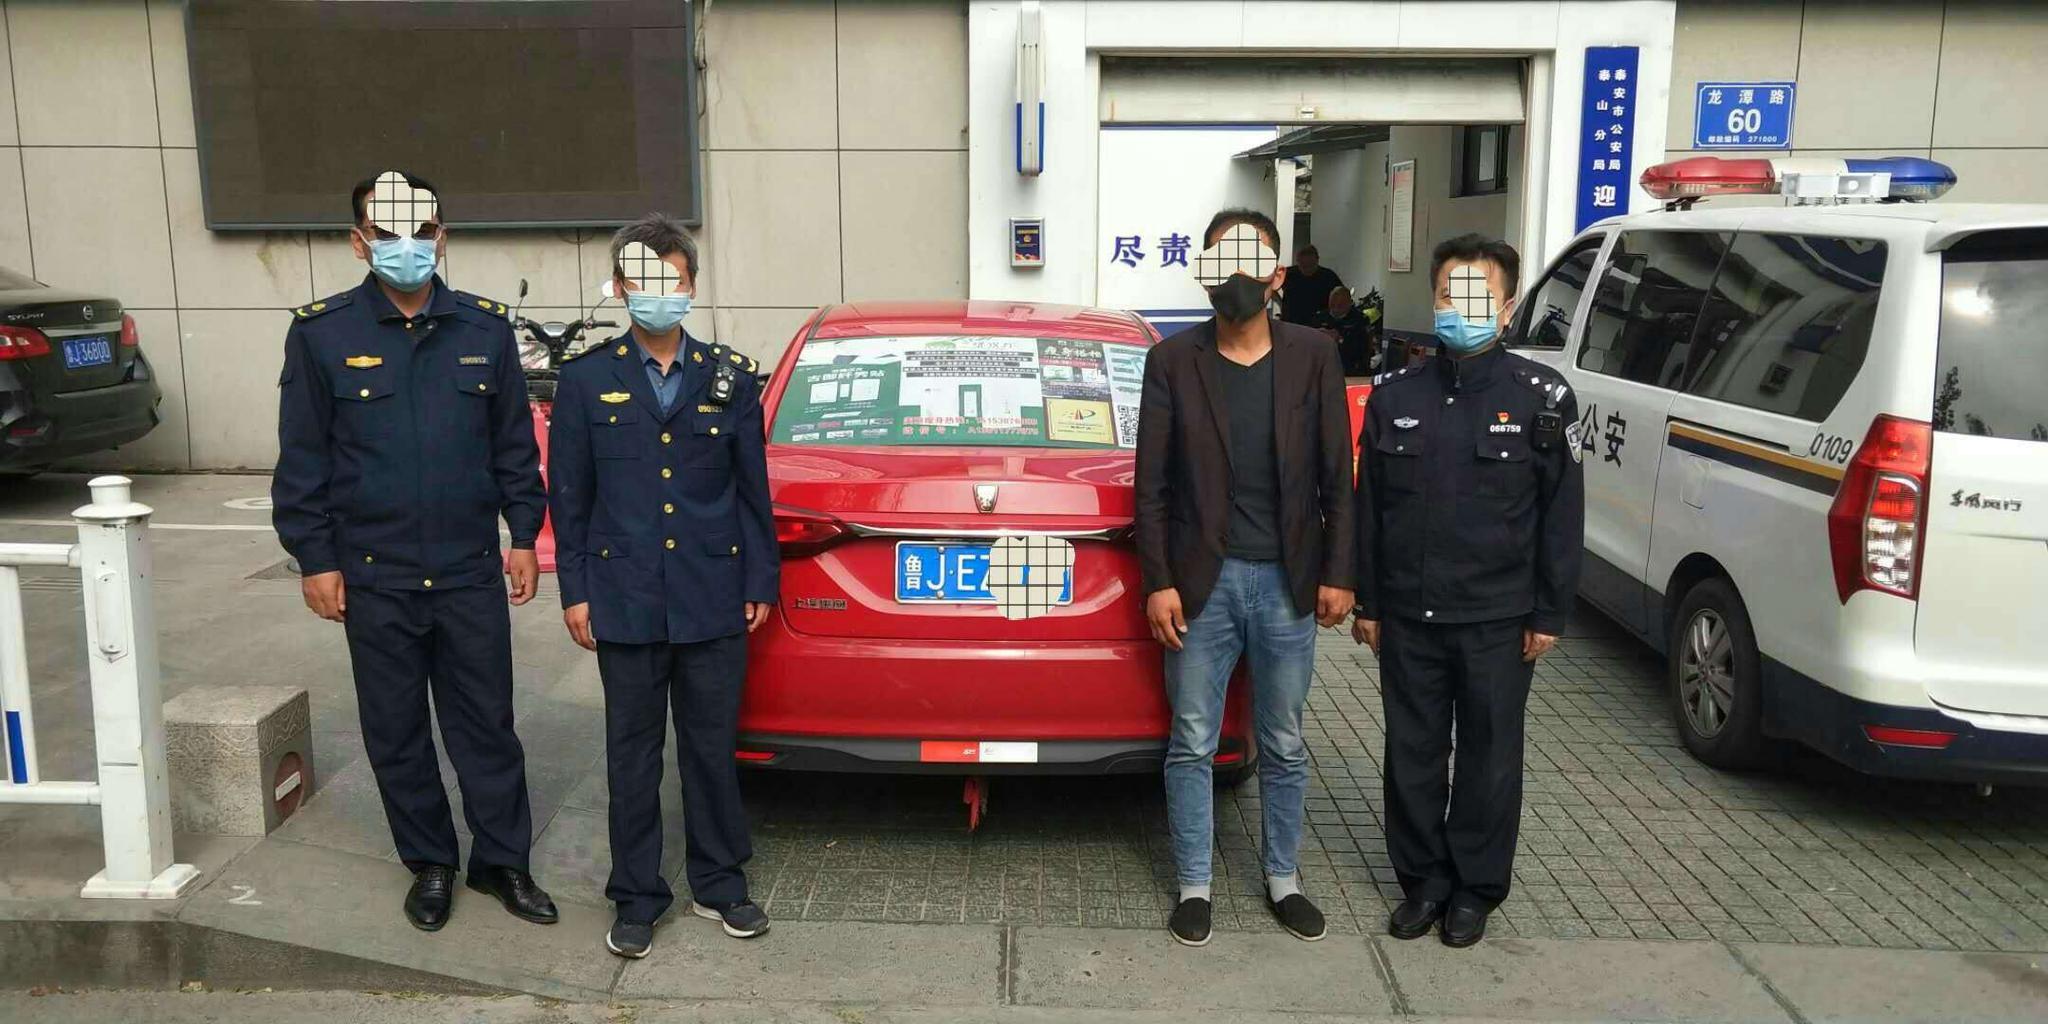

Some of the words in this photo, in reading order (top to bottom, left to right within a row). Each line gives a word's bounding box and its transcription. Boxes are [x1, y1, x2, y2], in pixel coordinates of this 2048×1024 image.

[1707, 89, 1785, 105] 龙潭路
[1592, 69, 1611, 171] 泰山分局
[1608, 68, 1627, 171] 泰安市公安局
[1727, 109, 1761, 133] 60
[1747, 135, 1778, 144] 271000
[1593, 185, 1616, 207] 迎
[1110, 233, 1192, 268] 尽责
[1810, 432, 1853, 464] 0109
